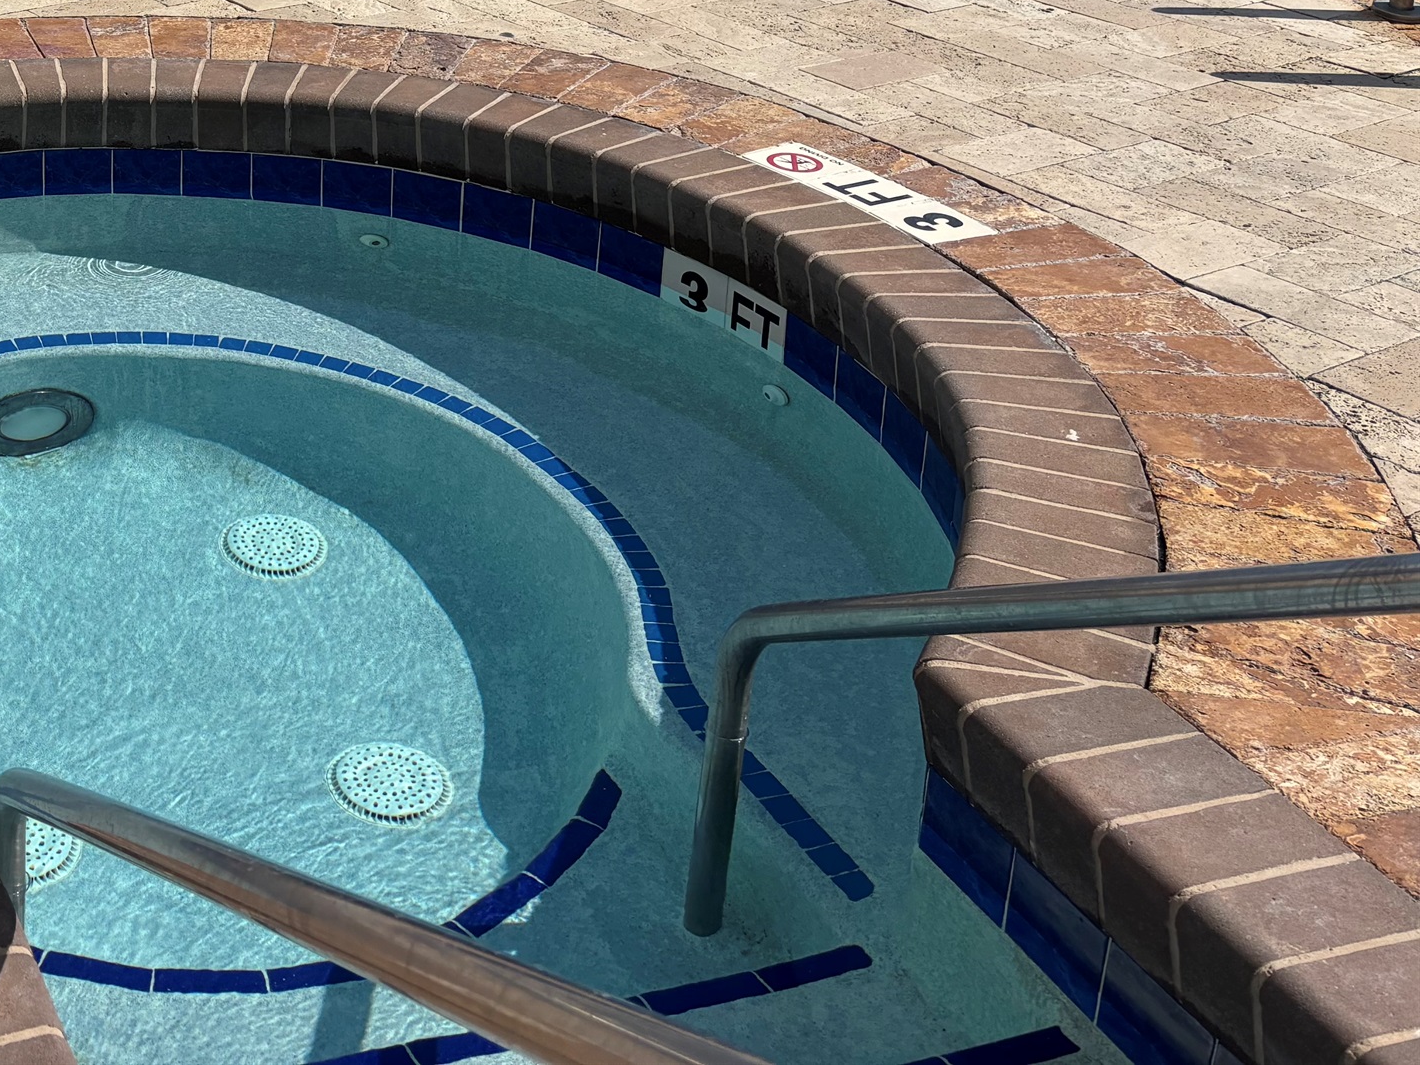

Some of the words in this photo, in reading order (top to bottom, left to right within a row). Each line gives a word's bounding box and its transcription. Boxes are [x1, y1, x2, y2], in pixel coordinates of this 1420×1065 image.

[822, 178, 914, 207] FT
[903, 212, 964, 232] 3
[678, 270, 709, 313] 3
[730, 290, 781, 351] FT
